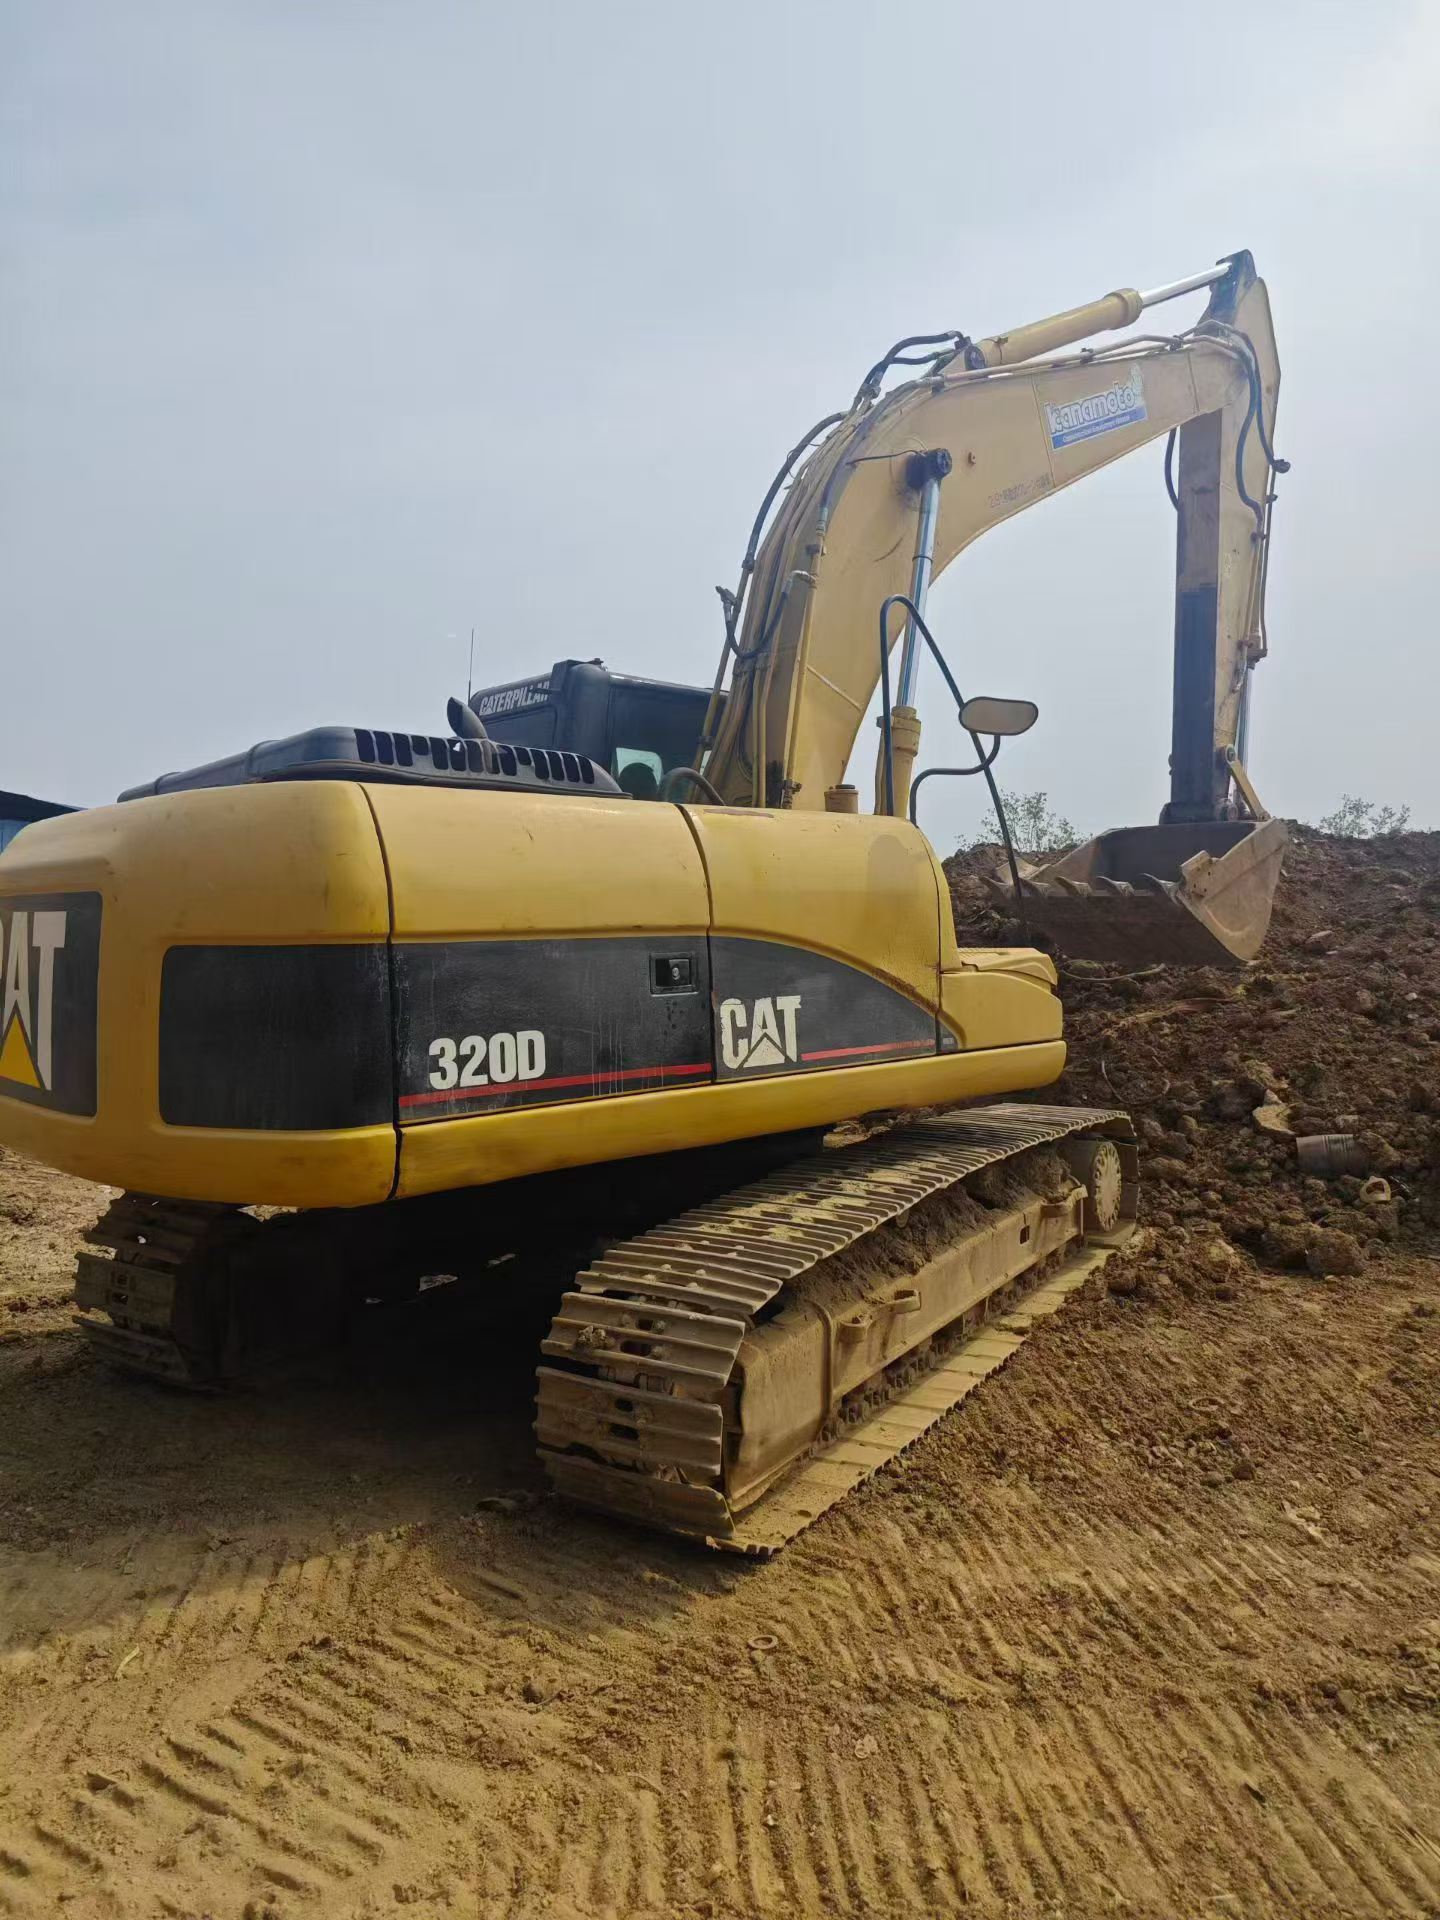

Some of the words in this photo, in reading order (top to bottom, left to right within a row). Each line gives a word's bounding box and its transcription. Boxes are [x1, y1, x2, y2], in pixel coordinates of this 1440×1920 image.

[0, 911, 67, 1091] AT
[720, 995, 801, 1070] CAT
[428, 1030, 546, 1090] 320D
